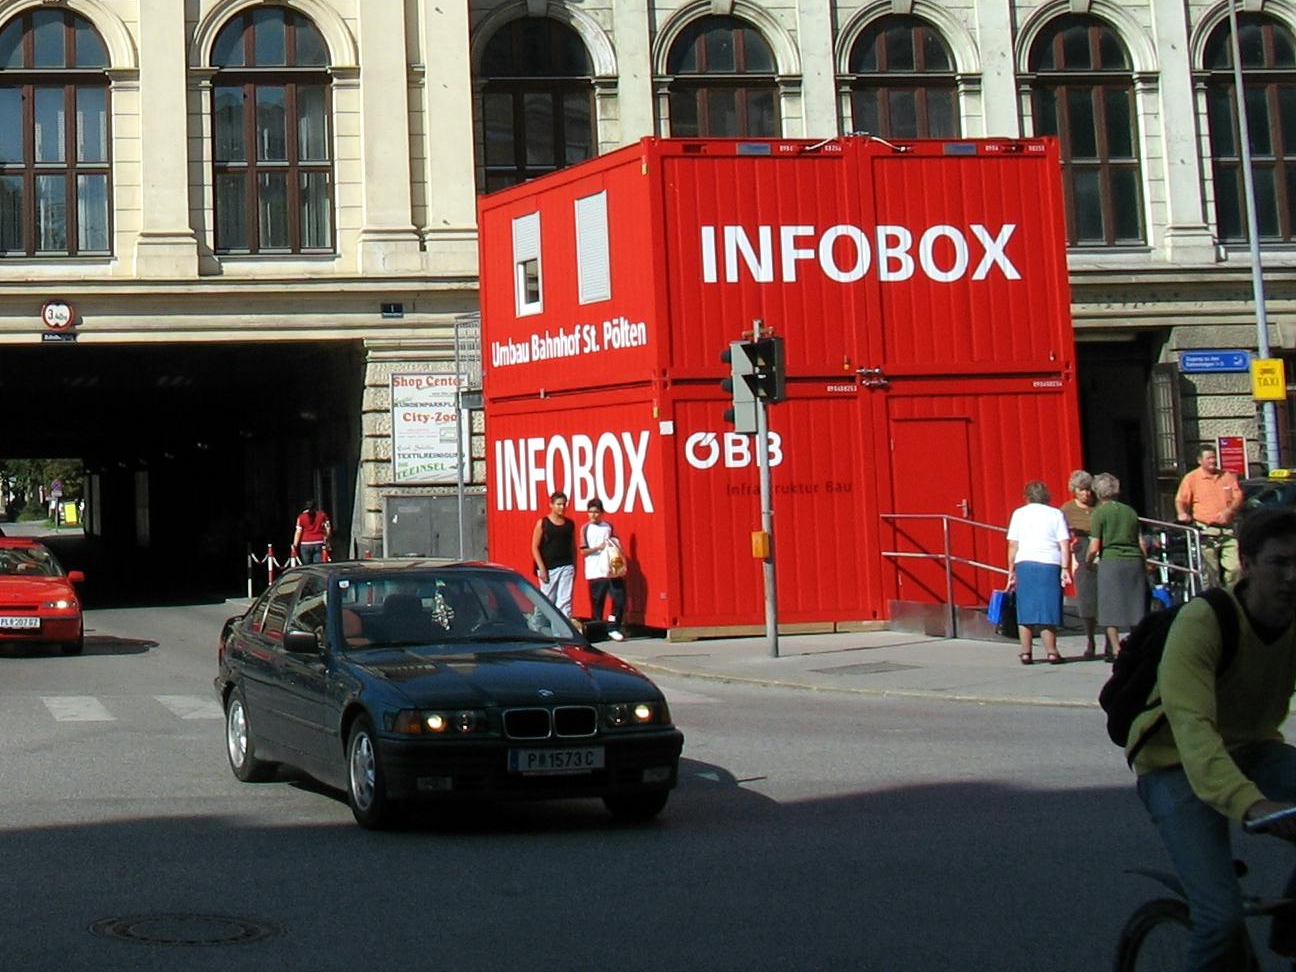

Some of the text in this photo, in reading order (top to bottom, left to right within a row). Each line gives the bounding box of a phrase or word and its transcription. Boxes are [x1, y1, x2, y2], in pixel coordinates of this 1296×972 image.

[700, 223, 1022, 284] INFOBOX
[492, 316, 647, 368] Umbau Bahnhof St. Pölten
[392, 376, 423, 389] Shop
[1256, 377, 1279, 387] TAXI
[495, 430, 655, 514] INFOBOX
[727, 482, 819, 496] Infraruktur
